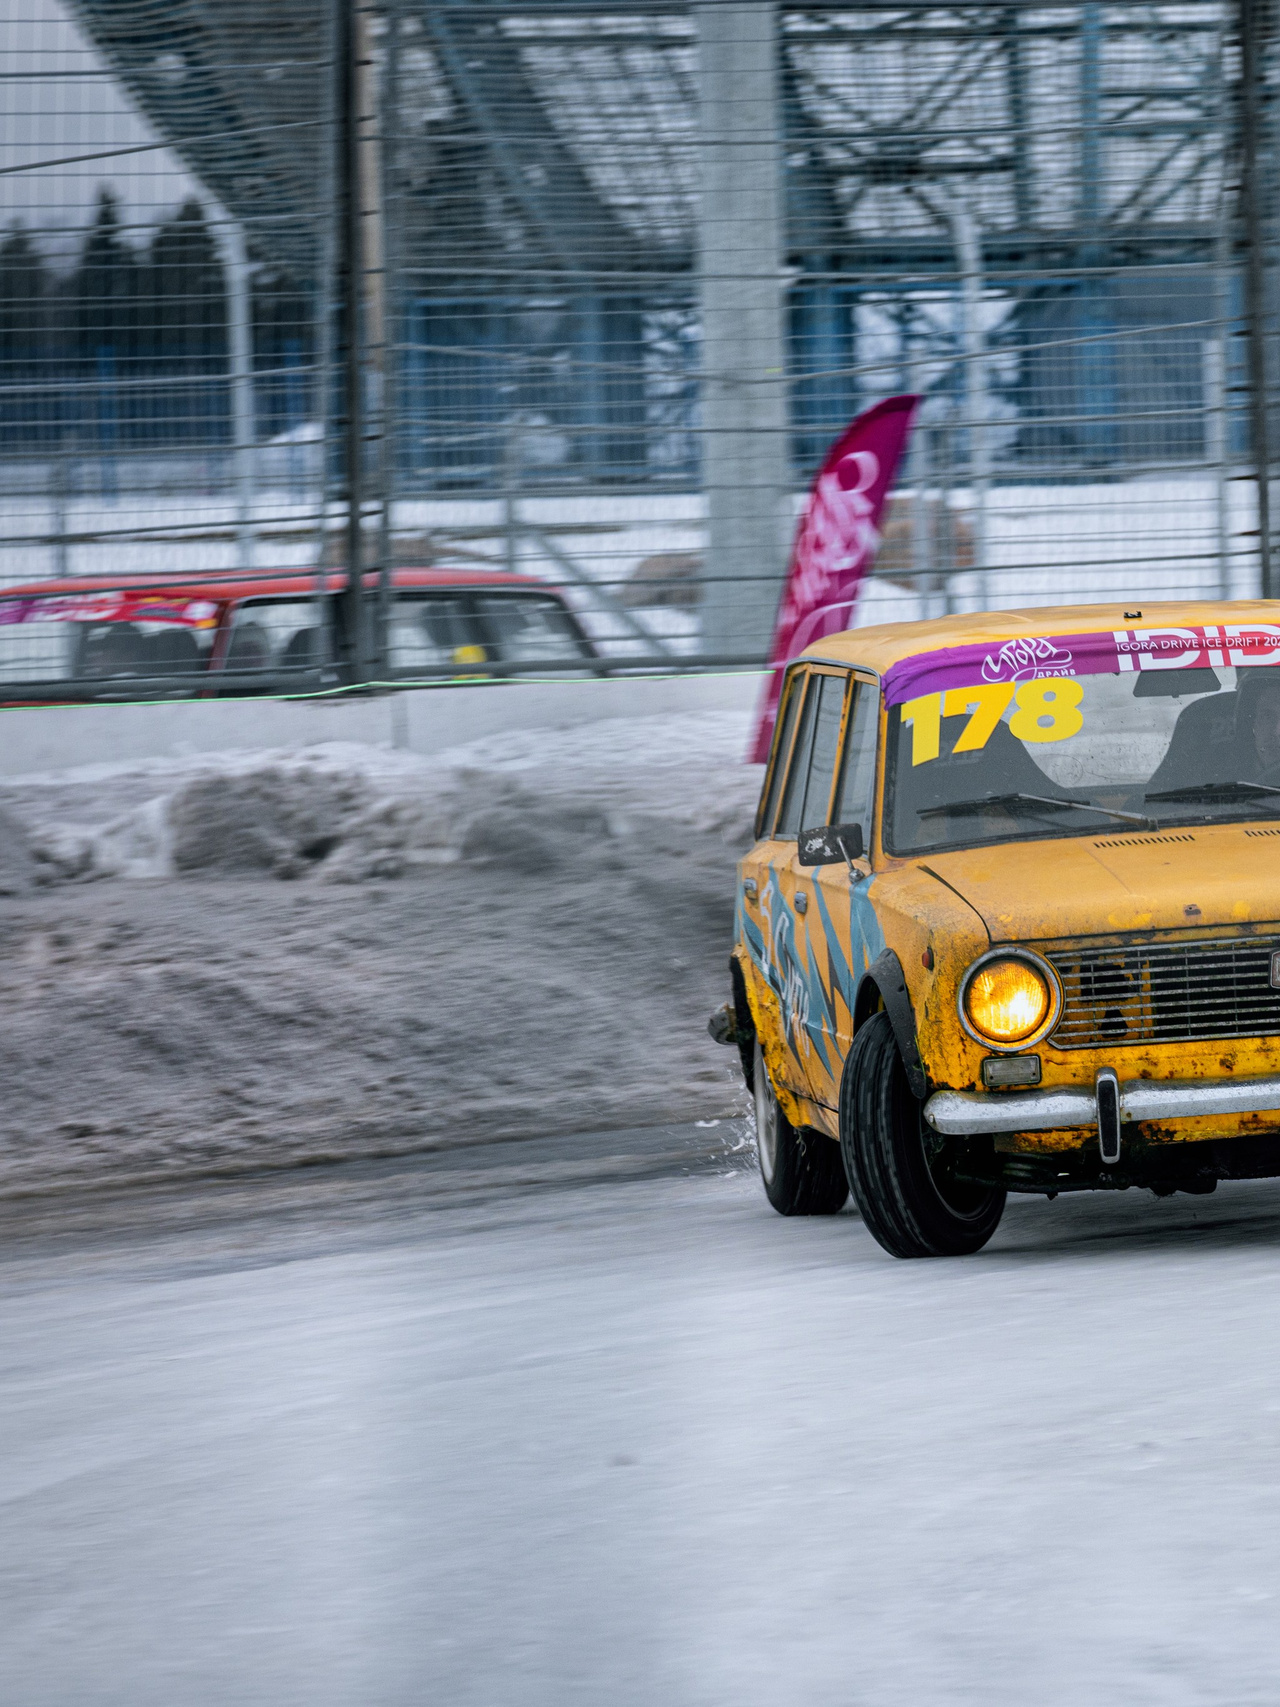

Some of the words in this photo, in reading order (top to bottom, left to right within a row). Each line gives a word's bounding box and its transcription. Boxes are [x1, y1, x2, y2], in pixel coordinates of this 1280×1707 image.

[1117, 641, 1158, 652] IGORA
[1161, 639, 1199, 649] DRIVE
[1203, 638, 1222, 648] ICE
[1226, 637, 1260, 647] DRIFT
[1037, 668, 1076, 678] ДРАЙВ
[901, 677, 1084, 767] 178
